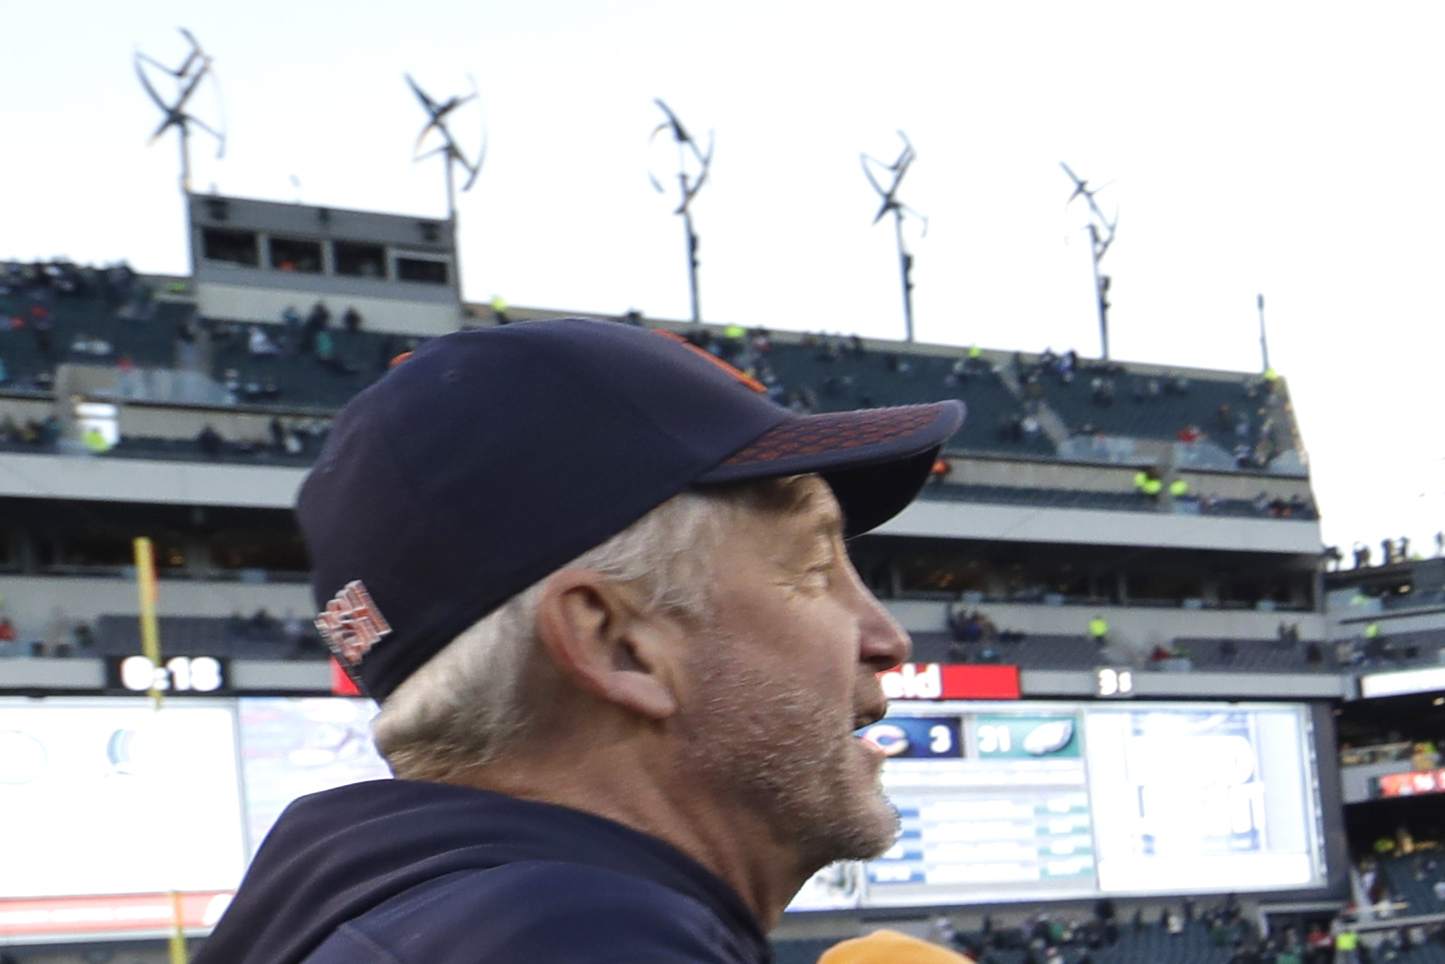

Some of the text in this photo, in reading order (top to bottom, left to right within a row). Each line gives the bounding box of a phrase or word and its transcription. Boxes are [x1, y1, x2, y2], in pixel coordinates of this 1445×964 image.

[880, 662, 942, 698] eld
[929, 724, 952, 753] 3
[977, 724, 1011, 752] 31
